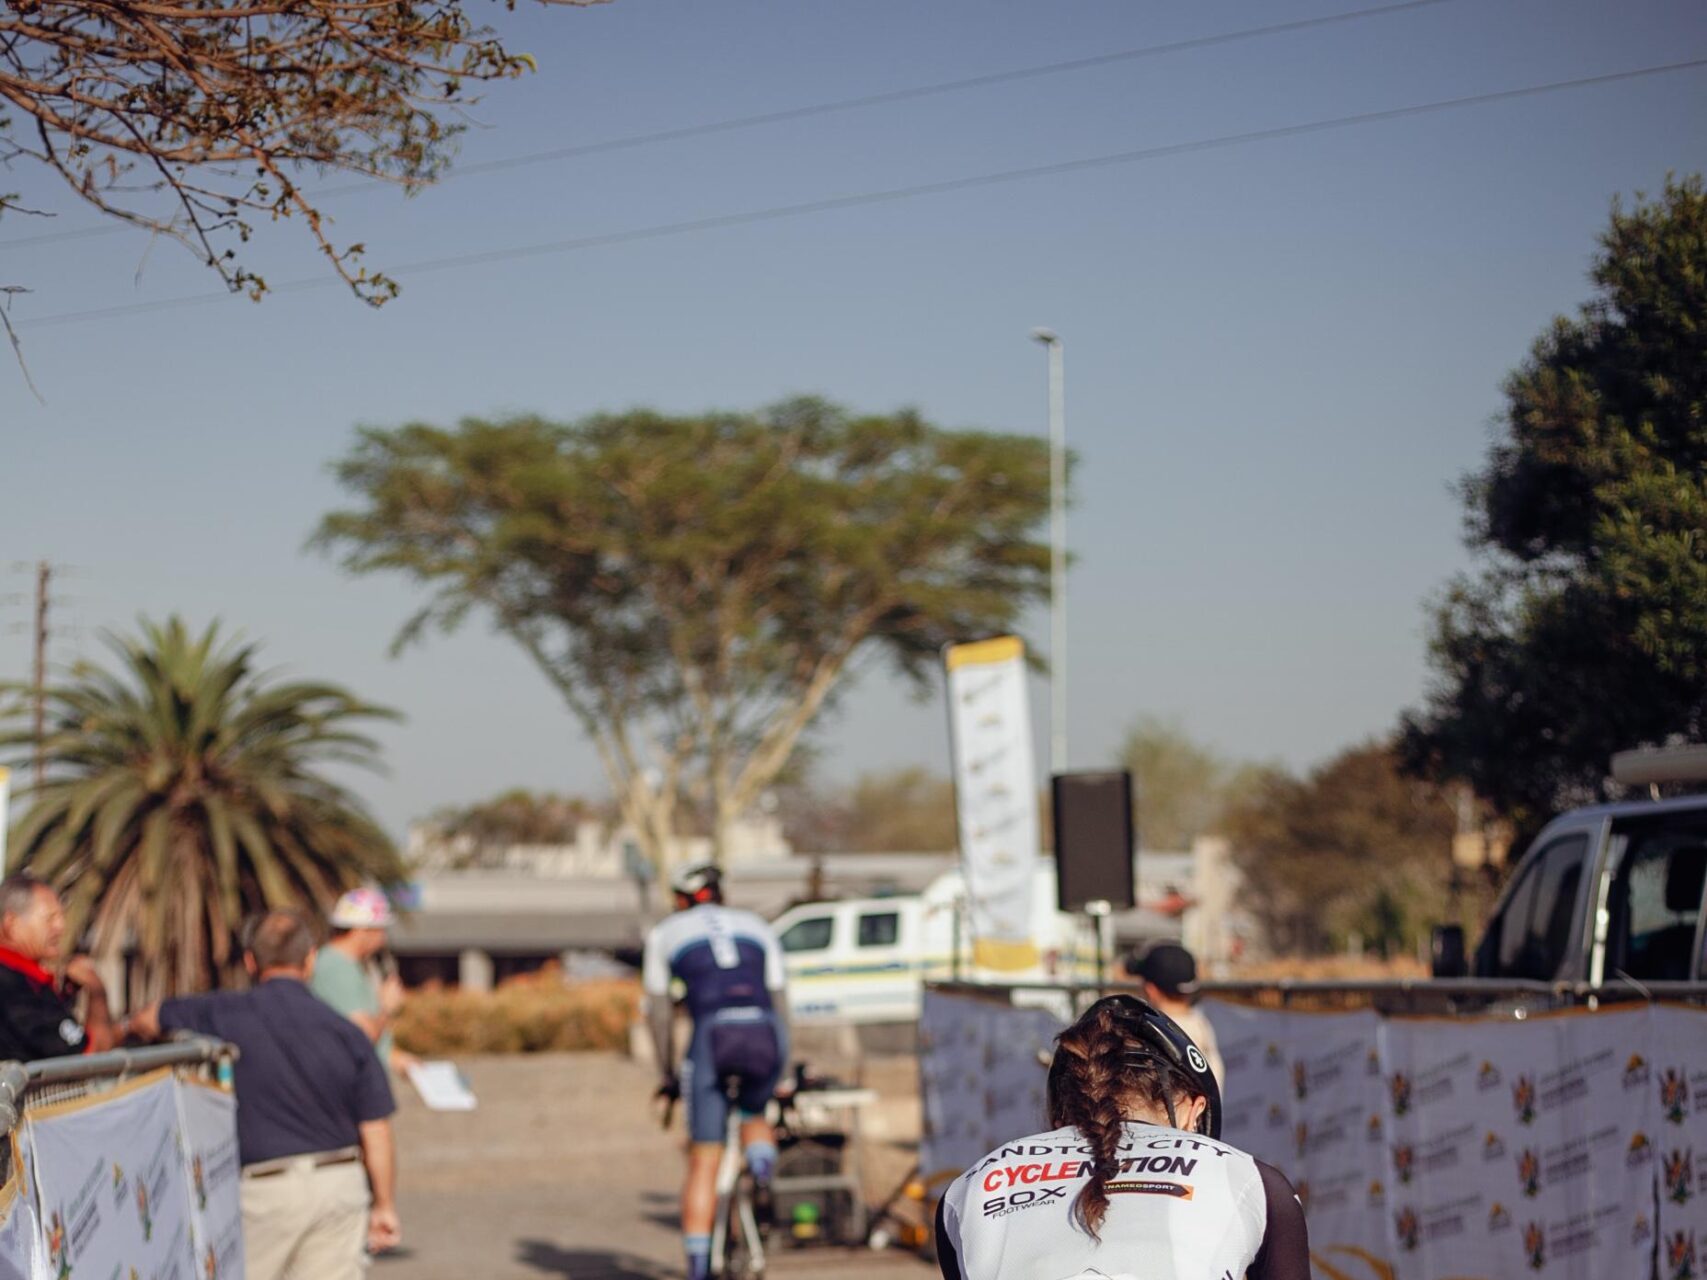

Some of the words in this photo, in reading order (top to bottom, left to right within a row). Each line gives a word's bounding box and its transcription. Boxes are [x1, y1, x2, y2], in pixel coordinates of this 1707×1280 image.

[1146, 1139, 1233, 1157] CITY
[983, 1155, 1199, 1192] CYCLENTION
[983, 1185, 1067, 1217] SOX
[992, 1199, 1056, 1220] FOOTWEAR
